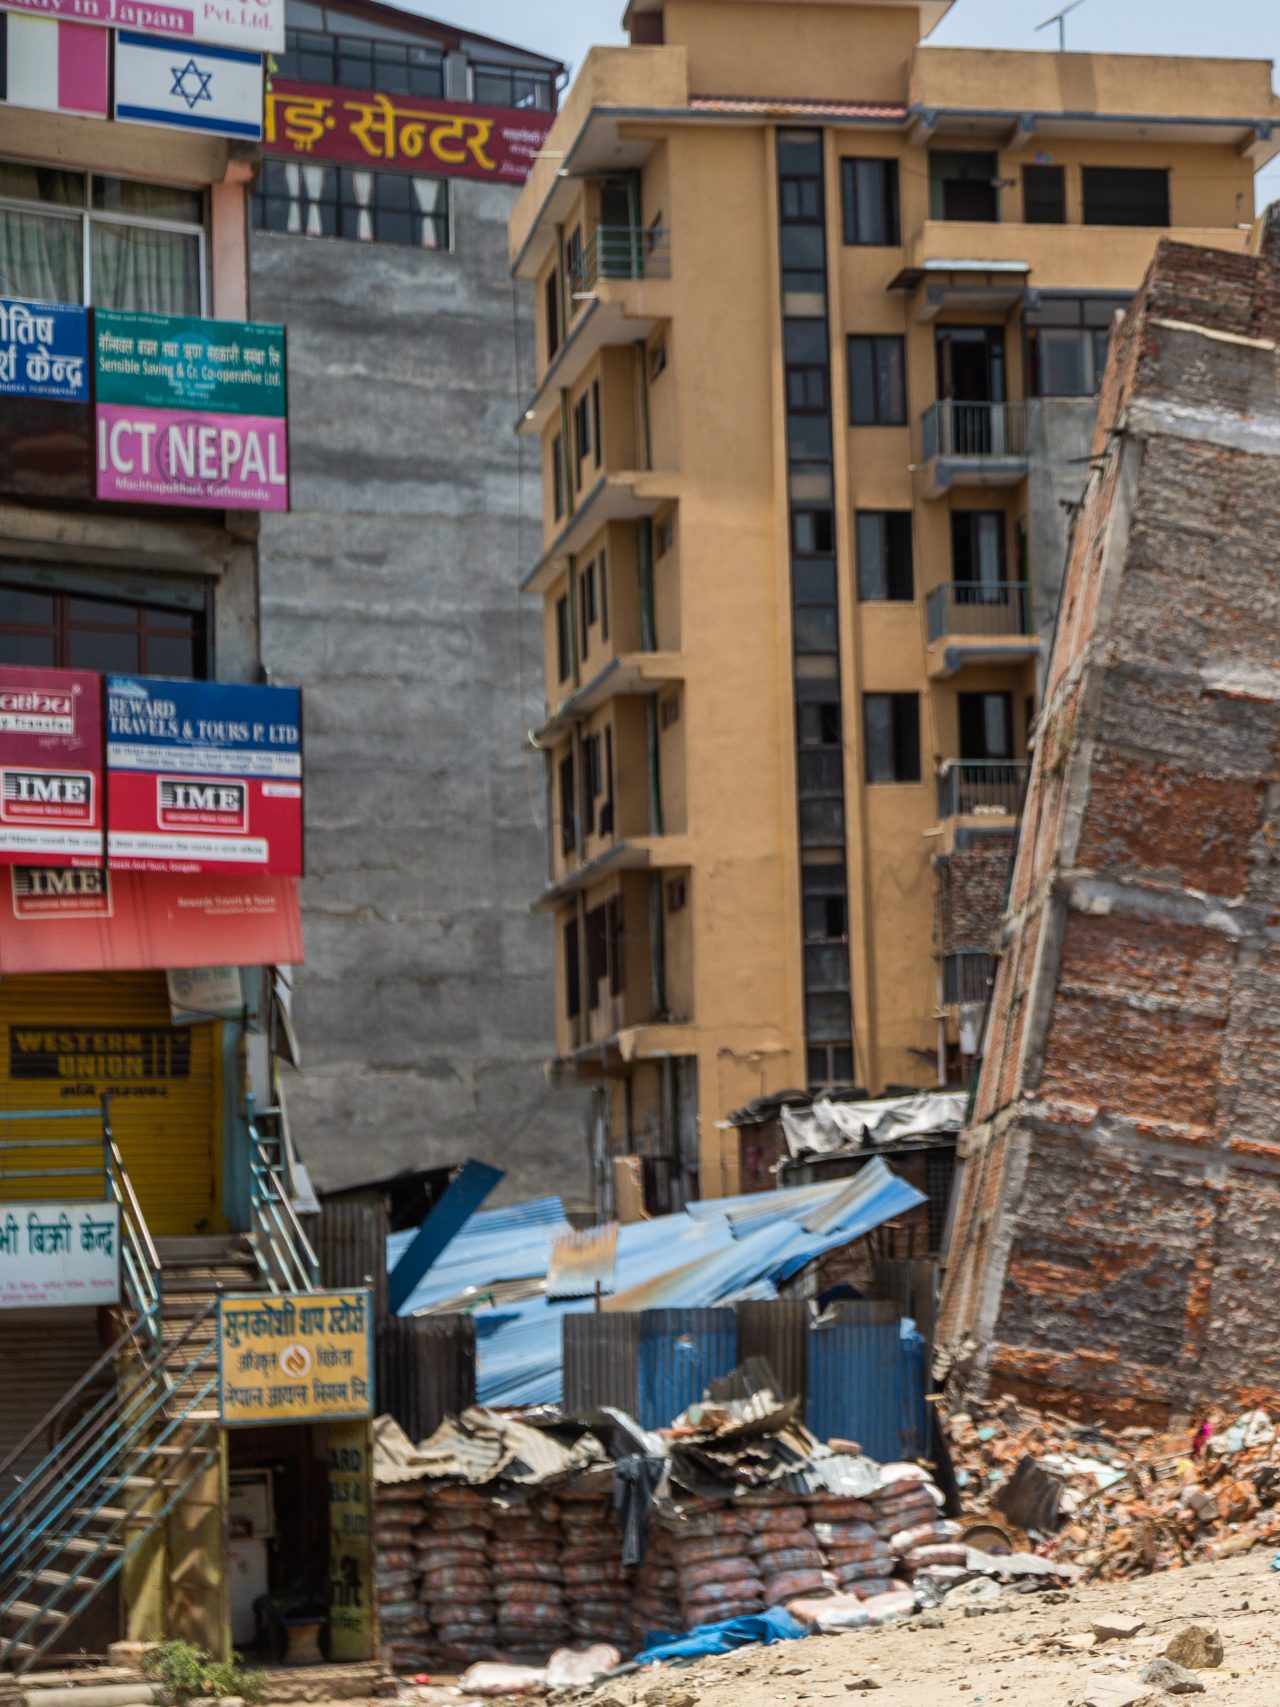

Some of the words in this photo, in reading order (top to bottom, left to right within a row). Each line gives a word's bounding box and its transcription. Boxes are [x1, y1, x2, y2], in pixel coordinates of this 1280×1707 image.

[107, 0, 185, 30] Japan
[204, 3, 236, 24] Pvt.
[241, 8, 274, 32] Ltd.
[344, 93, 496, 171] सेन्टर
[26, 344, 83, 389] केन्द्र
[99, 356, 140, 375] Sensible
[143, 360, 174, 379] Saving
[176, 362, 184, 378] &
[187, 363, 198, 379] Cr.
[202, 366, 262, 385] Co-operative
[265, 372, 281, 387] Ltd.
[98, 417, 157, 476] ICT
[168, 423, 286, 486] NEPAL
[207, 485, 269, 501] Kathmandu
[109, 697, 176, 719] REWARD
[110, 716, 179, 738] TRAVELS
[182, 719, 194, 739] &
[197, 720, 250, 743] TOURS
[269, 723, 299, 745] LTD
[16, 776, 86, 804] IME
[173, 784, 240, 812] IME
[31, 868, 100, 895] IME
[16, 1031, 143, 1052] WESTERN
[57, 1054, 144, 1078] UNION
[329, 1447, 362, 1474] ARD
